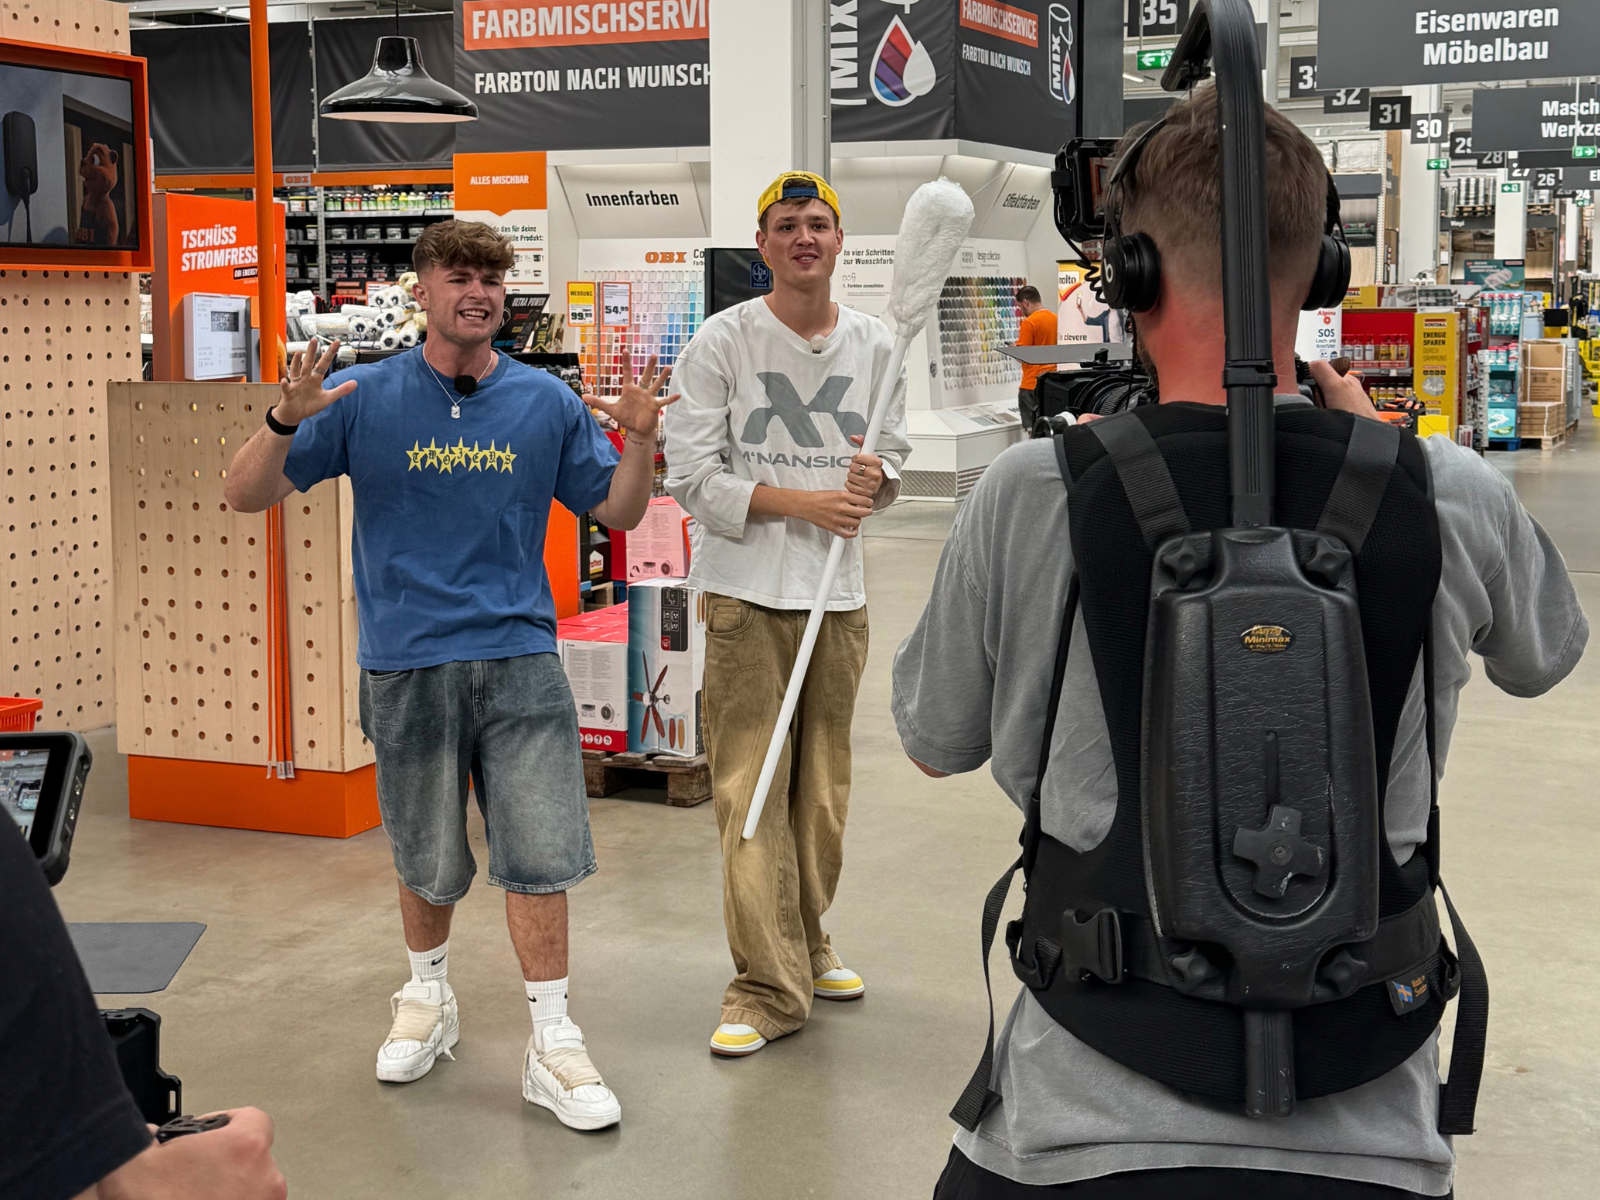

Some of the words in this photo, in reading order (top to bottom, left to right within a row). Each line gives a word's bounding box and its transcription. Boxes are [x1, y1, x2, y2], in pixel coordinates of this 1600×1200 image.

[962, 0, 1037, 40] FARBMISCHSERVICE
[1142, 0, 1178, 25] 35
[1415, 8, 1559, 34] Eisenwaren
[962, 43, 989, 65] FARBTON
[990, 51, 1006, 70] NACH
[1007, 55, 1031, 76] WUNSCH
[1052, 34, 1061, 90] MIX
[1423, 38, 1549, 65] Möbelbau
[474, 69, 560, 94] FARBTON
[567, 67, 620, 91] NACH
[1298, 65, 1317, 90] 3
[1332, 89, 1361, 106] 32
[1379, 103, 1401, 124] 31
[1416, 119, 1442, 139] 30
[1482, 151, 1503, 164] 28
[470, 176, 491, 185] ALLES
[492, 175, 529, 185] MISCHBAR
[1537, 173, 1555, 186] 26
[586, 190, 679, 207] Innenfarben
[181, 224, 237, 249] TSCHÜSS
[645, 252, 687, 263] OBI
[1318, 329, 1335, 337] SOS
